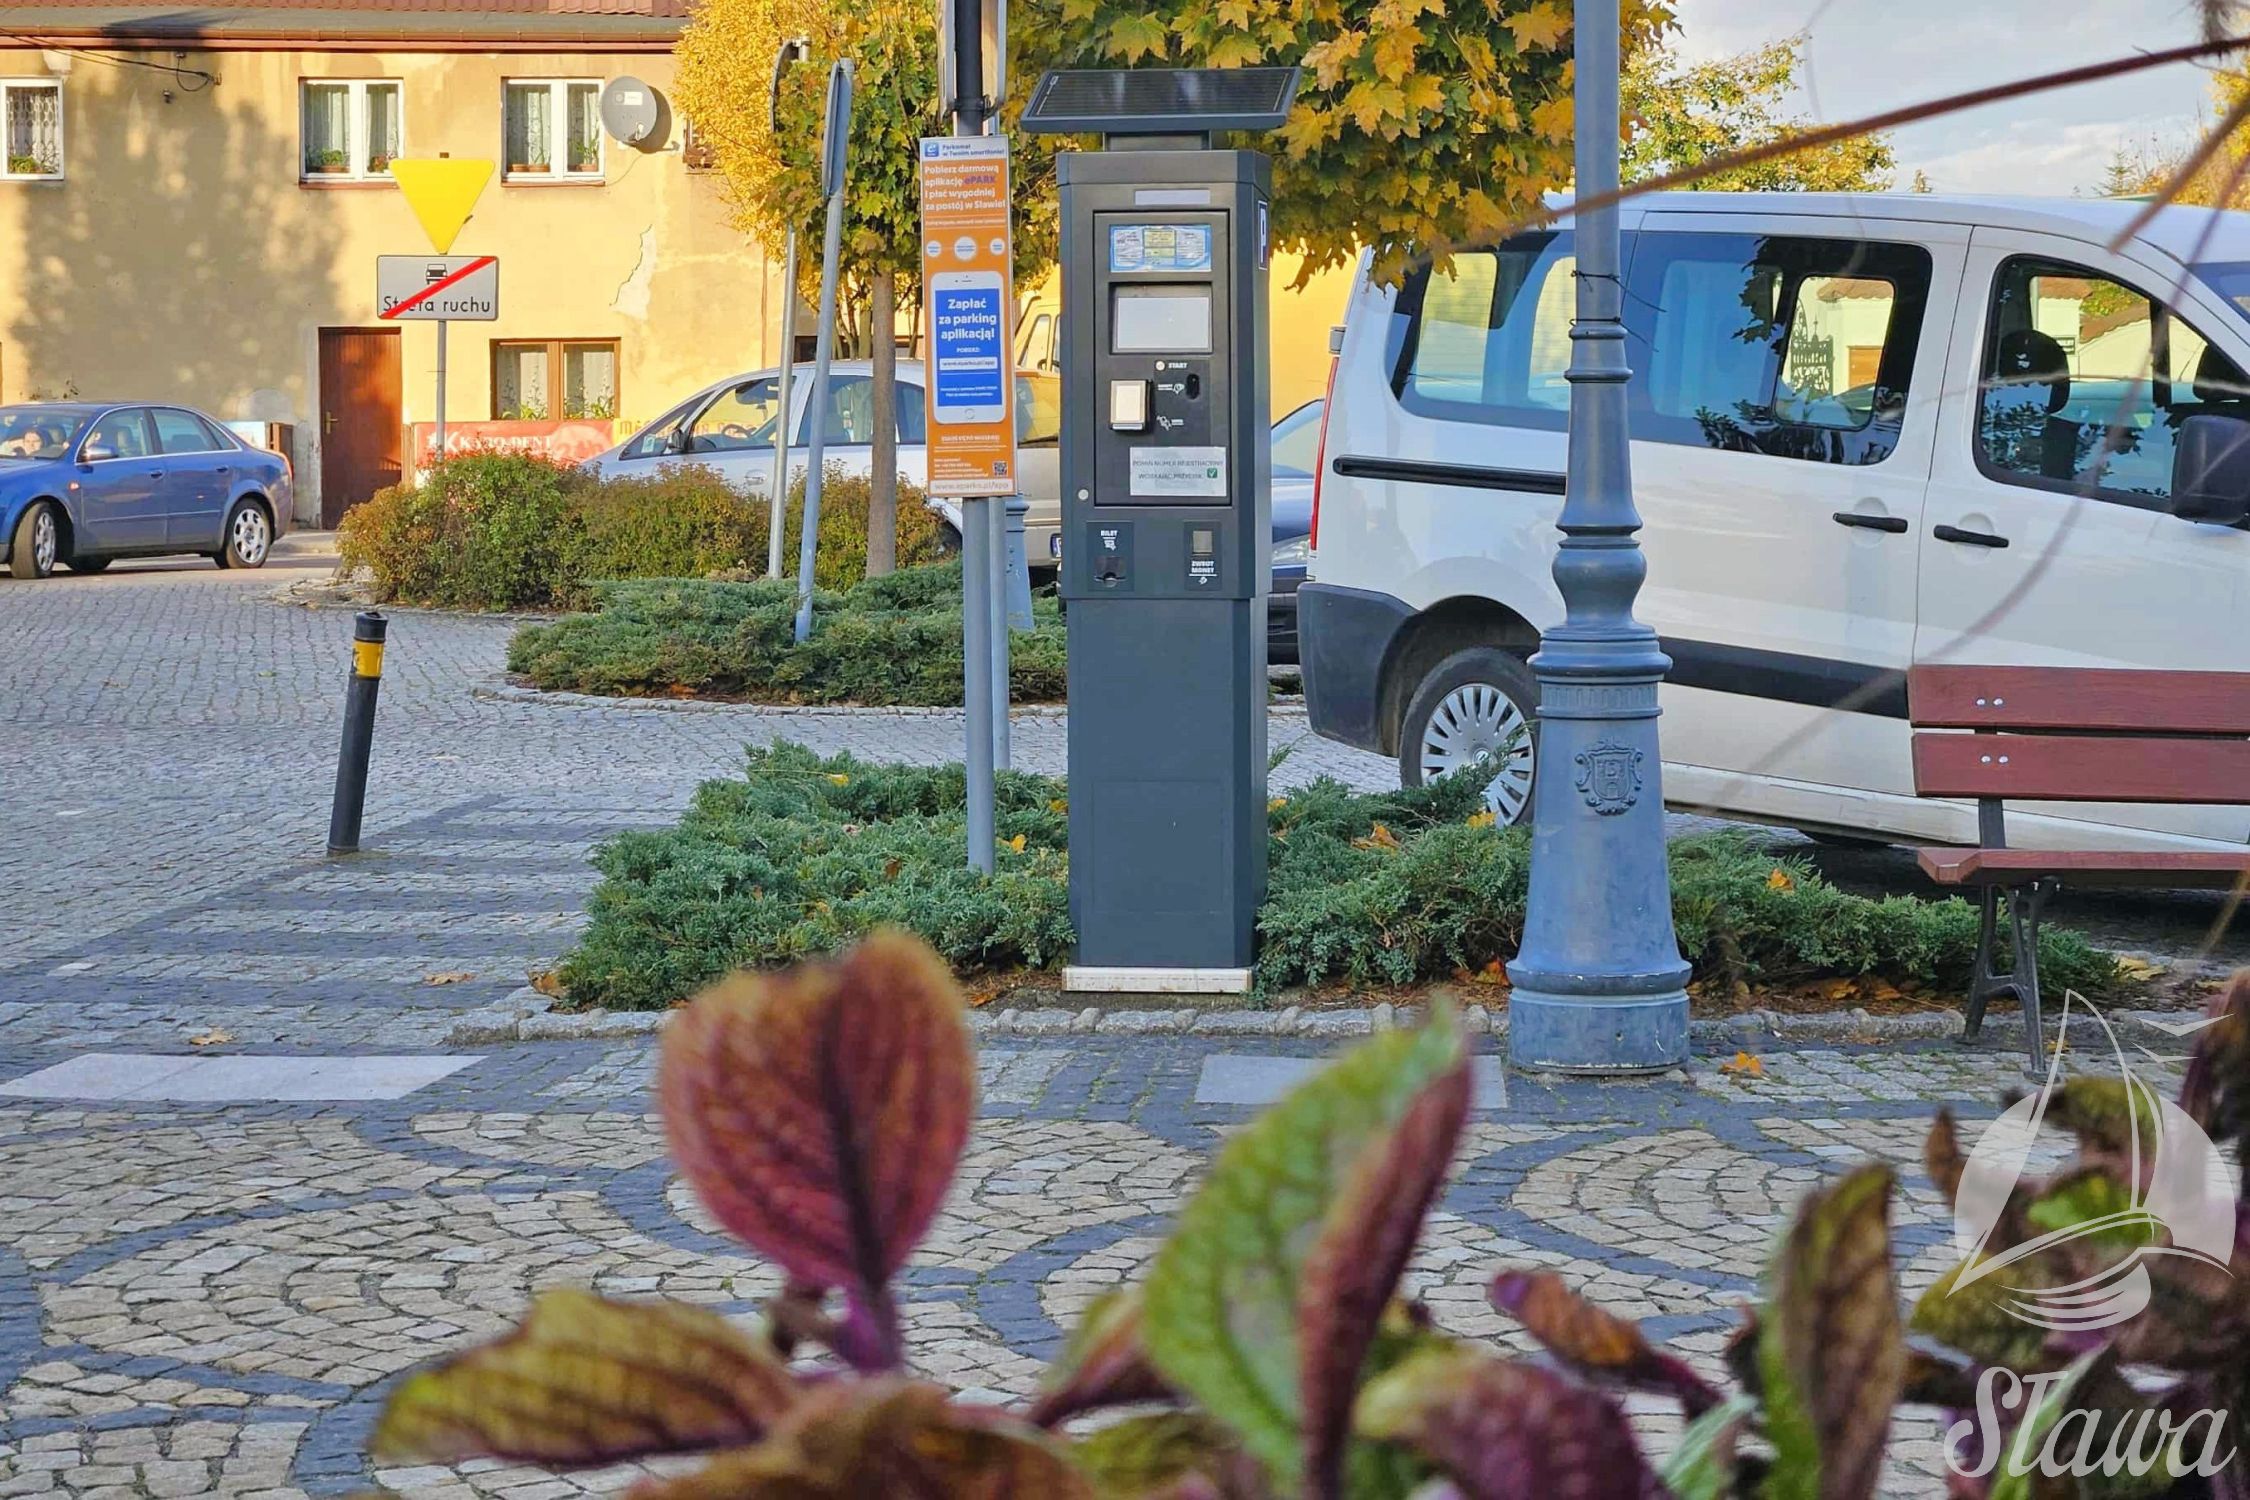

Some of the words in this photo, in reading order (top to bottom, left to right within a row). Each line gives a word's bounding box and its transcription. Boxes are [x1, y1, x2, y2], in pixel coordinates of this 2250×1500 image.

[925, 165, 957, 174] Pobierz
[958, 164, 999, 174] darmową
[949, 188, 996, 199] wygodniej
[443, 296, 491, 312] ruchu
[947, 297, 987, 311] Zapłać
[938, 315, 952, 325] za
[953, 312, 997, 327] parking
[941, 327, 995, 342] aplikacją!
